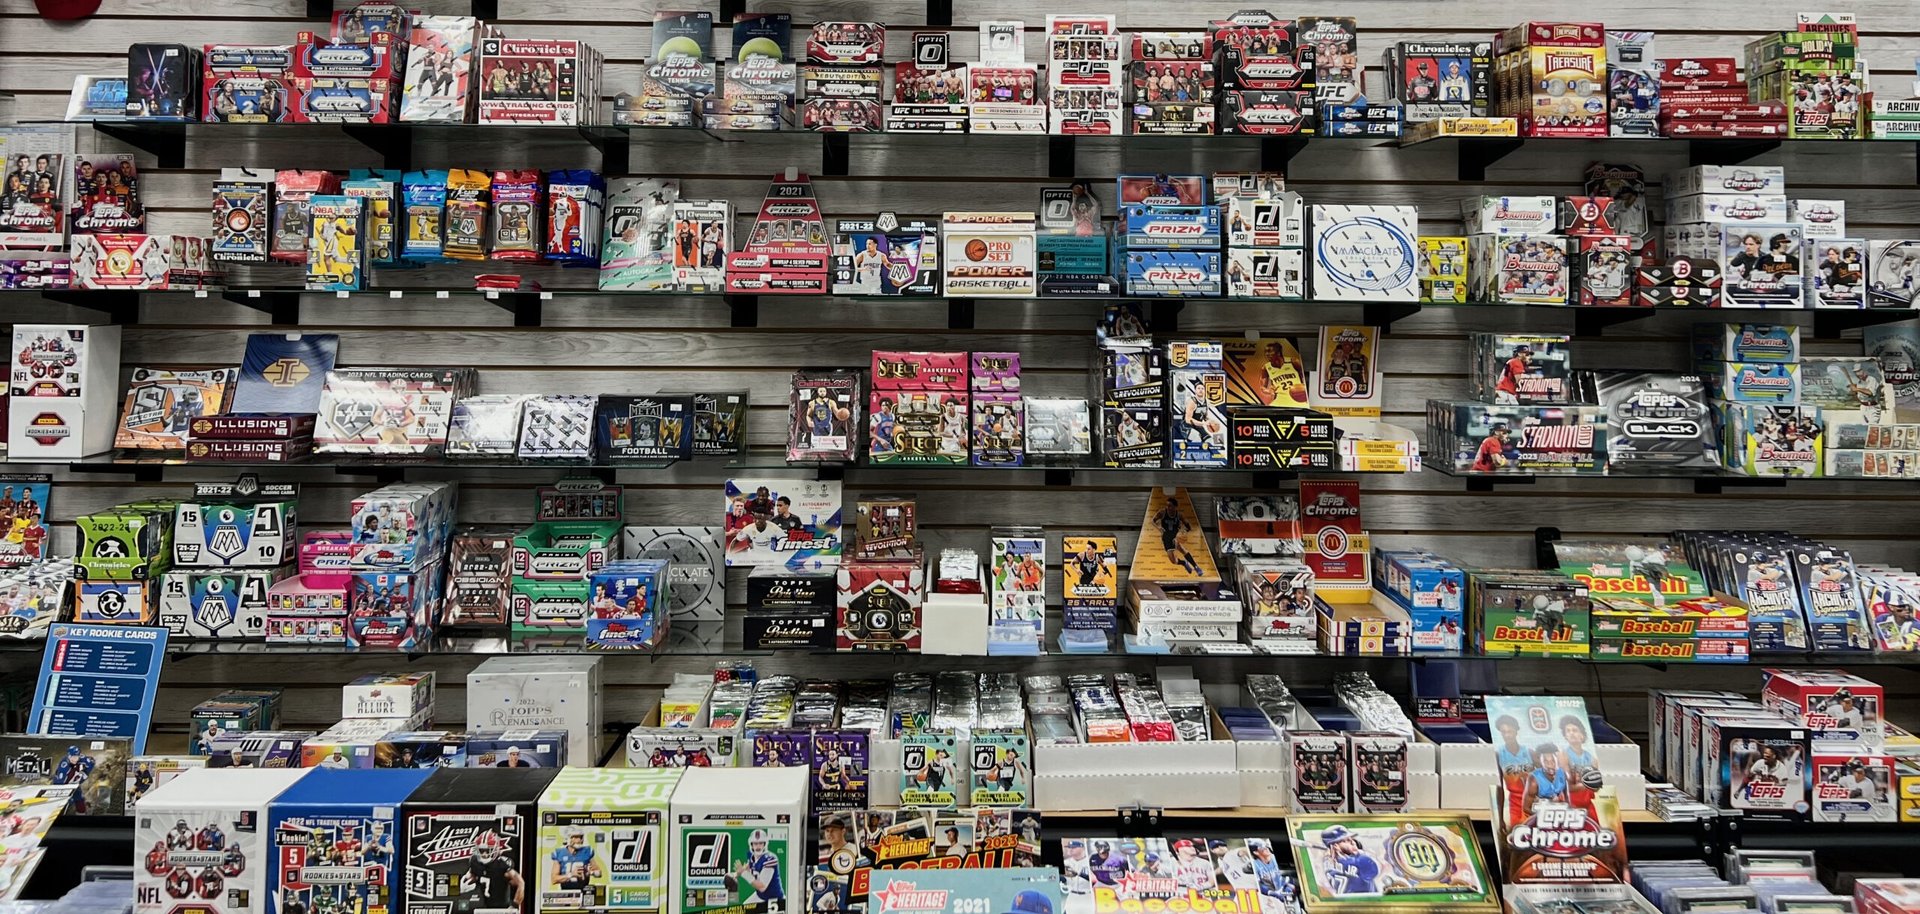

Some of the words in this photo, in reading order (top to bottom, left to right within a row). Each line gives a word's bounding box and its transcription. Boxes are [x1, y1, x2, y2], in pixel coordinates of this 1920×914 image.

[1306, 32, 1348, 41] Chrome
[503, 43, 575, 55] Chronicles
[1409, 43, 1471, 54] Chronicles
[1802, 41, 1832, 55] HOLIDAY
[1548, 56, 1593, 74] TREASURE
[650, 67, 711, 80] Chrome
[731, 67, 791, 80] Chrome
[1248, 67, 1292, 76] PRIZM
[1673, 69, 1708, 79] Chrome
[1368, 108, 1385, 117] UFC
[1725, 180, 1765, 189] Chrome
[780, 186, 802, 195] 2021
[314, 206, 335, 215] NBA
[769, 206, 811, 214] PRIZM
[1727, 210, 1767, 219] Chrome
[967, 215, 1014, 224] POWER
[1497, 211, 1541, 222] Bowman
[1, 217, 52, 228] Chrome
[80, 217, 138, 228] Chrome
[839, 222, 874, 230] 2021-22
[1149, 225, 1200, 235] PRIZM
[989, 242, 1011, 251] PRO
[214, 254, 264, 263] Chronicles
[837, 256, 850, 265] 15
[989, 253, 1009, 262] SET
[1505, 256, 1559, 273] Bowman
[837, 271, 849, 279] 10
[954, 265, 1026, 278] POWER
[1149, 271, 1200, 281] PRIZM
[950, 281, 1030, 290] BASKETBALL
[1740, 332, 1788, 348] Bowman
[1191, 347, 1219, 355] 2023-24
[878, 361, 919, 376] SELECT
[14, 371, 28, 382] NFL
[1742, 372, 1790, 387] Bowman
[1517, 378, 1551, 391] STADIUM
[1118, 388, 1160, 397] REVOLUTION
[1620, 403, 1701, 418] Chrome
[127, 413, 163, 424] SPECTRA
[214, 420, 287, 430] ILLUSIONS
[1237, 426, 1252, 435] 10
[1254, 426, 1270, 434] PACKS
[1301, 425, 1309, 435] 5
[1311, 425, 1328, 433] CARDS
[1631, 424, 1694, 433] BLACK
[1517, 425, 1577, 448] STADIUM
[211, 444, 283, 453] ILLUSIONS
[895, 436, 941, 453] SELECT
[622, 447, 667, 455] FOOTBALL
[1118, 449, 1160, 459] REVOLUTION
[1759, 441, 1814, 462] Bowman
[1237, 454, 1252, 464] 10
[198, 487, 231, 495] 2021-22
[182, 512, 197, 522] 15
[1306, 506, 1357, 517] Chrome
[776, 537, 837, 554] finest
[260, 546, 274, 557] 10
[516, 551, 525, 560] 12
[592, 551, 602, 560] 12
[89, 562, 132, 571] Chronicles
[536, 559, 581, 567] PRIZM
[167, 582, 184, 593] 15
[516, 597, 525, 607] 12
[1812, 590, 1855, 606] ARCHIVES
[537, 605, 582, 614] PRIZM
[362, 624, 399, 636] finest
[1622, 620, 1693, 636] Baseball
[69, 628, 88, 639] KEY
[89, 630, 122, 640] ROOKIE
[125, 631, 157, 641] CARDS
[1622, 644, 1693, 657] Baseball
[357, 702, 396, 713] ALLURE
[511, 708, 551, 716] TOPPS
[757, 737, 793, 754] SELECT
[816, 737, 852, 754] SELECT
[7, 760, 50, 773] METAL
[986, 835, 1018, 849] 2023
[1514, 827, 1614, 848] Chrome
[890, 838, 929, 856] HERITAGE
[290, 849, 297, 862] 5
[1405, 843, 1437, 871] GQ
[614, 864, 648, 872] DONRUSS
[304, 872, 334, 880] ROOKIES
[338, 872, 362, 880] STARS
[415, 872, 424, 889] 5
[480, 878, 490, 897] 7
[1137, 879, 1175, 890] HERITAGE
[138, 887, 162, 903] NFL
[615, 889, 622, 904] 5
[900, 890, 946, 907] HERITAGE
[1203, 889, 1230, 898] 2022
[768, 898, 778, 912] 5
[954, 899, 990, 913] 2021
